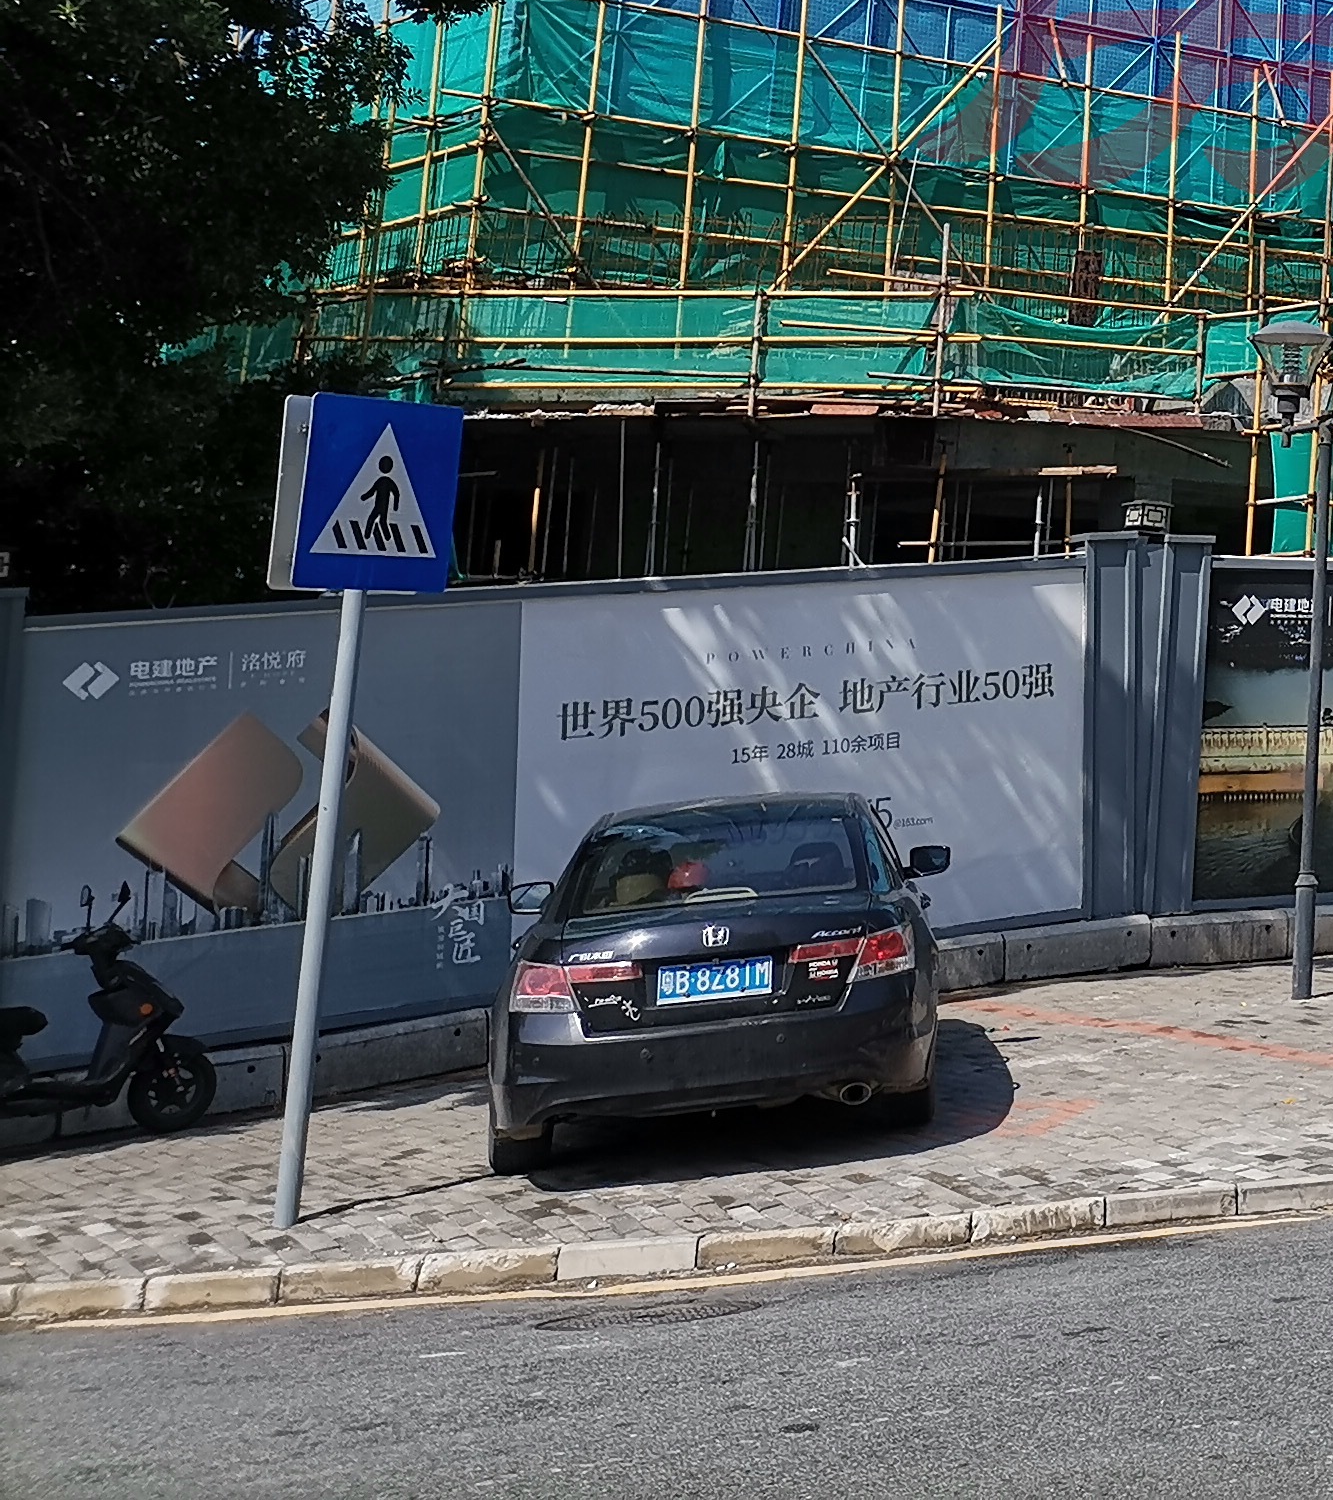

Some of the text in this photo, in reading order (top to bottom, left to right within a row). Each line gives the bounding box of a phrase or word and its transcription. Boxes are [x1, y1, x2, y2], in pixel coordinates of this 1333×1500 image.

[1269, 597, 1313, 614] 电建地
[129, 655, 218, 680] 电建地产
[240, 649, 306, 672] 洺悦府
[556, 662, 1056, 742] 世界500强央企 地产行业50强
[731, 731, 901, 765] 15年 28城 110余项目
